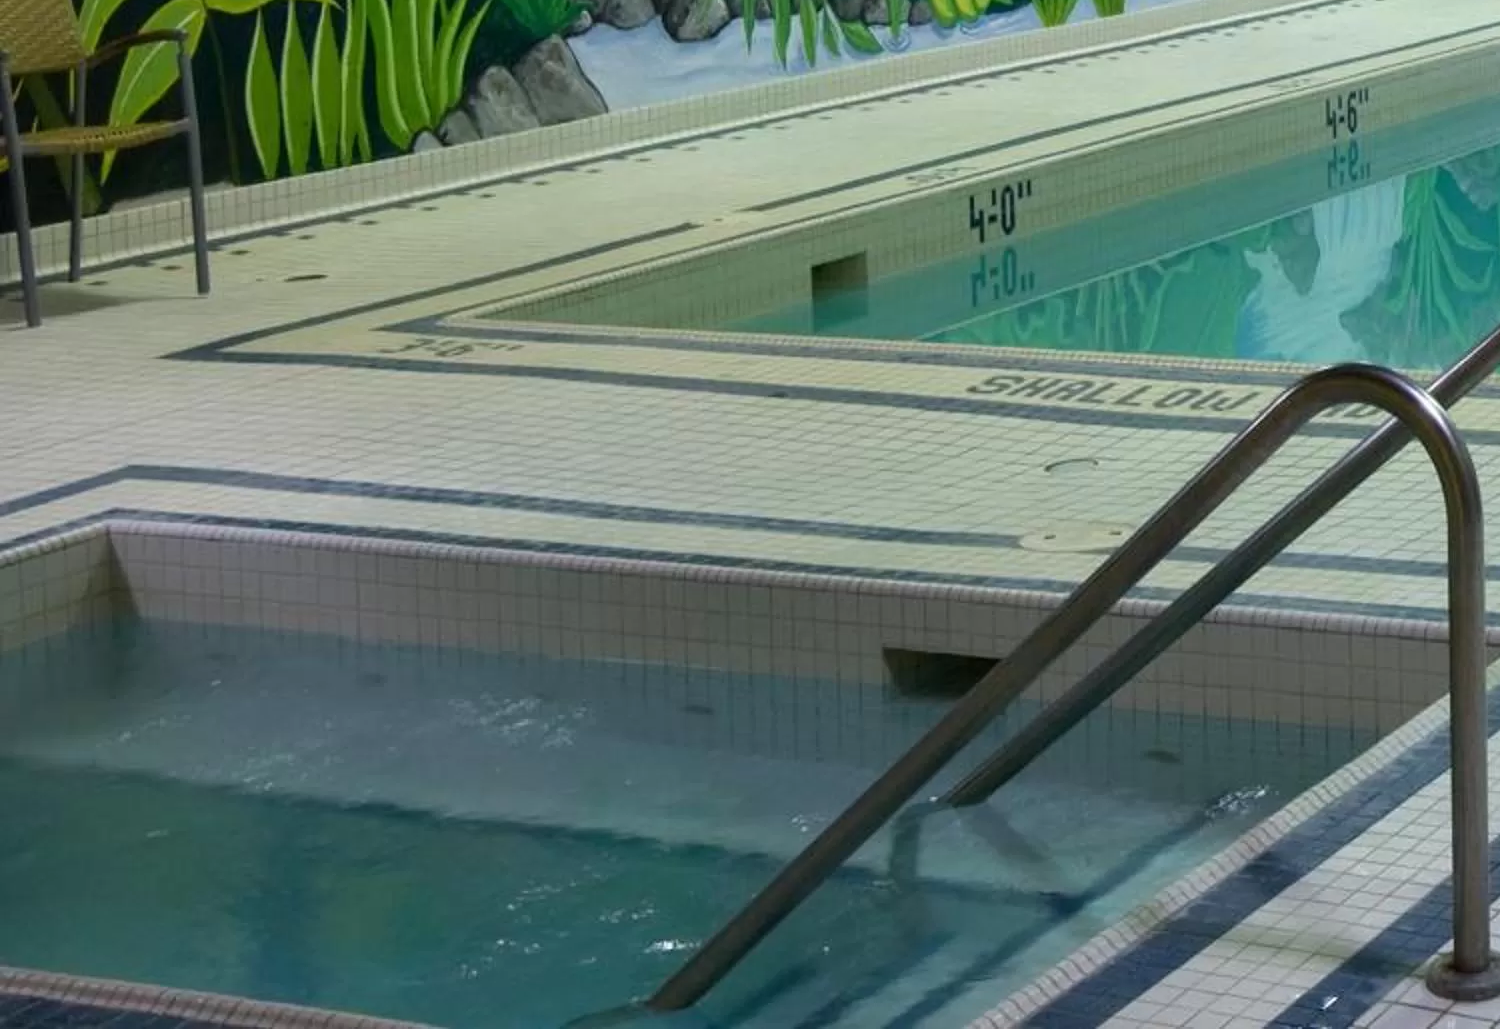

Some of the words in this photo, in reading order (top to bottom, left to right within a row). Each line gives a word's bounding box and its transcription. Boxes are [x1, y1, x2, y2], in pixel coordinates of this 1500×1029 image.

[1325, 86, 1369, 139] 4'-6"
[969, 179, 1032, 243] 4'-0"
[966, 375, 1259, 411] SHALLOW
